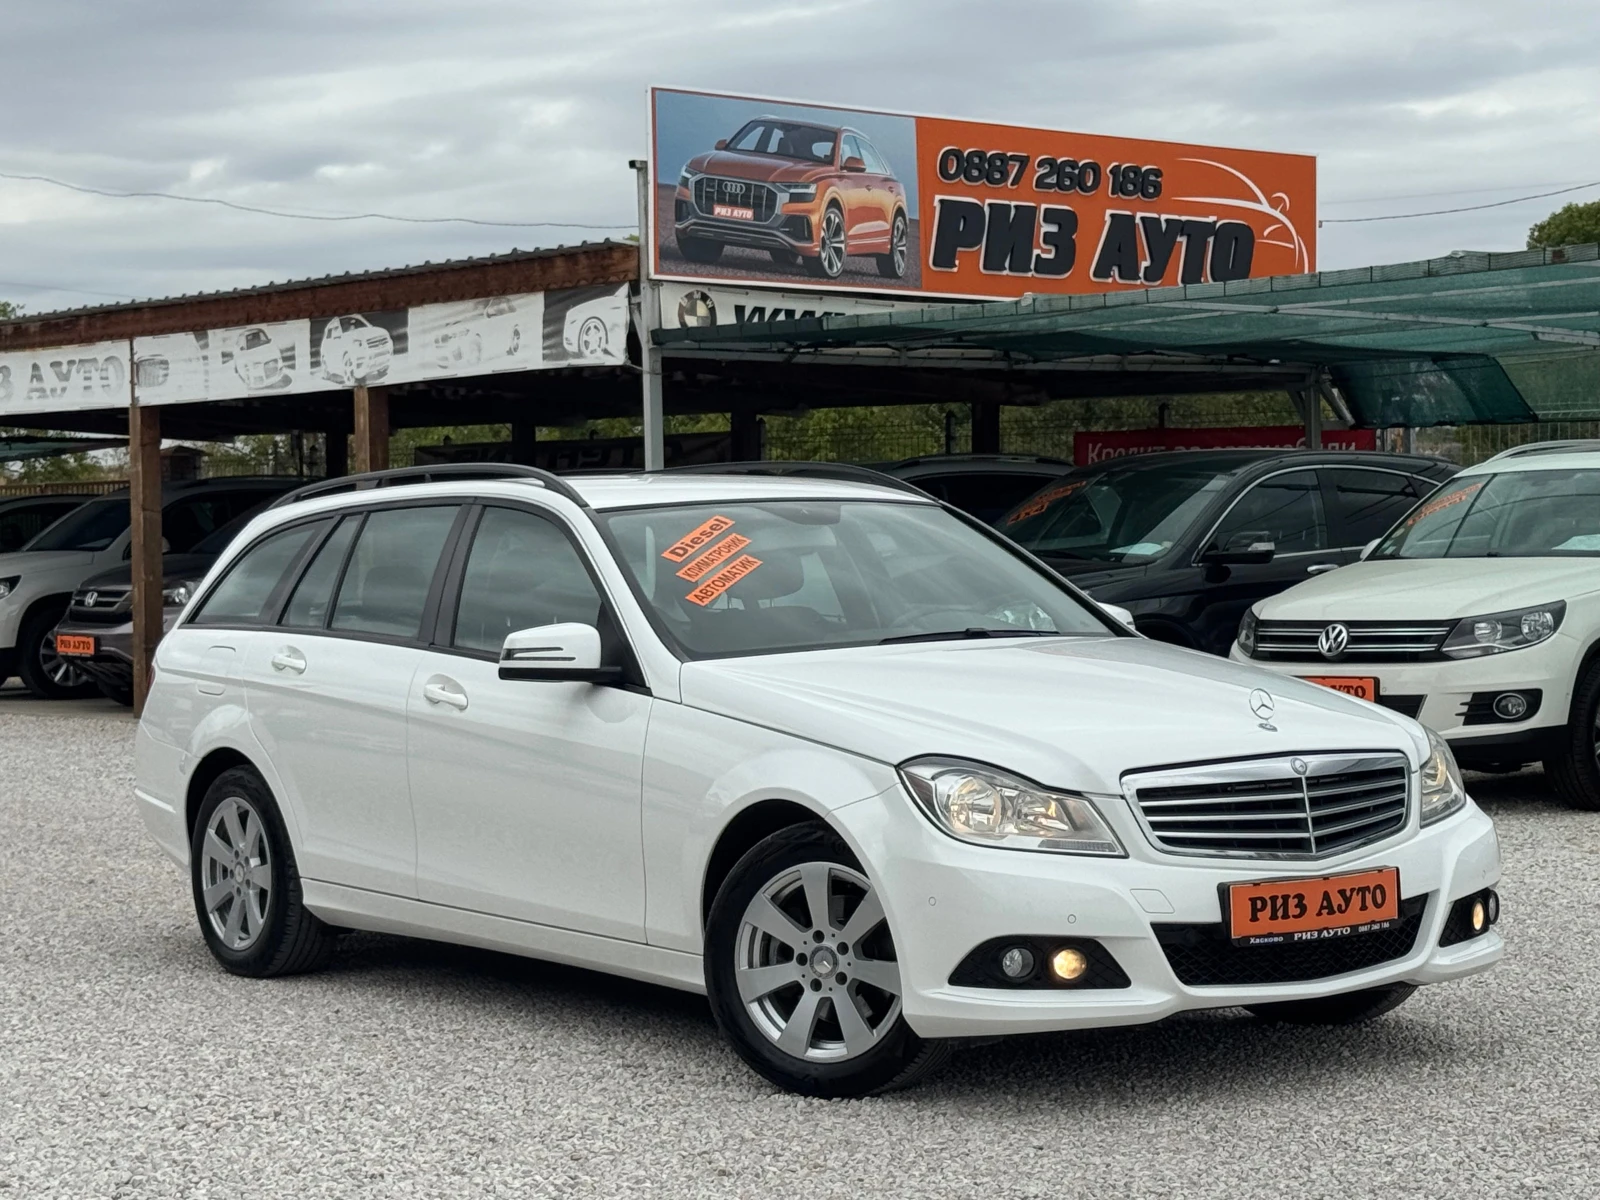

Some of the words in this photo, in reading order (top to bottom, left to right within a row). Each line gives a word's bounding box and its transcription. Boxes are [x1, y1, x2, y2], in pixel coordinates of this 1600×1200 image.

[937, 146, 1030, 189] 0887
[1033, 155, 1101, 196] 260
[1107, 162, 1163, 201] 186
[714, 206, 731, 217] РИЗ
[733, 210, 753, 219] АУТО
[930, 194, 1079, 280] РИЗ
[1089, 208, 1255, 287] АУТО
[24, 355, 125, 400] АУТО
[668, 518, 730, 558] Diesel
[693, 556, 758, 603] АВТОМАТИК
[1248, 893, 1308, 923] РИЗ
[1315, 884, 1387, 917] АУТО
[1294, 931, 1319, 941] РИЗ
[1320, 926, 1351, 938] АУТО
